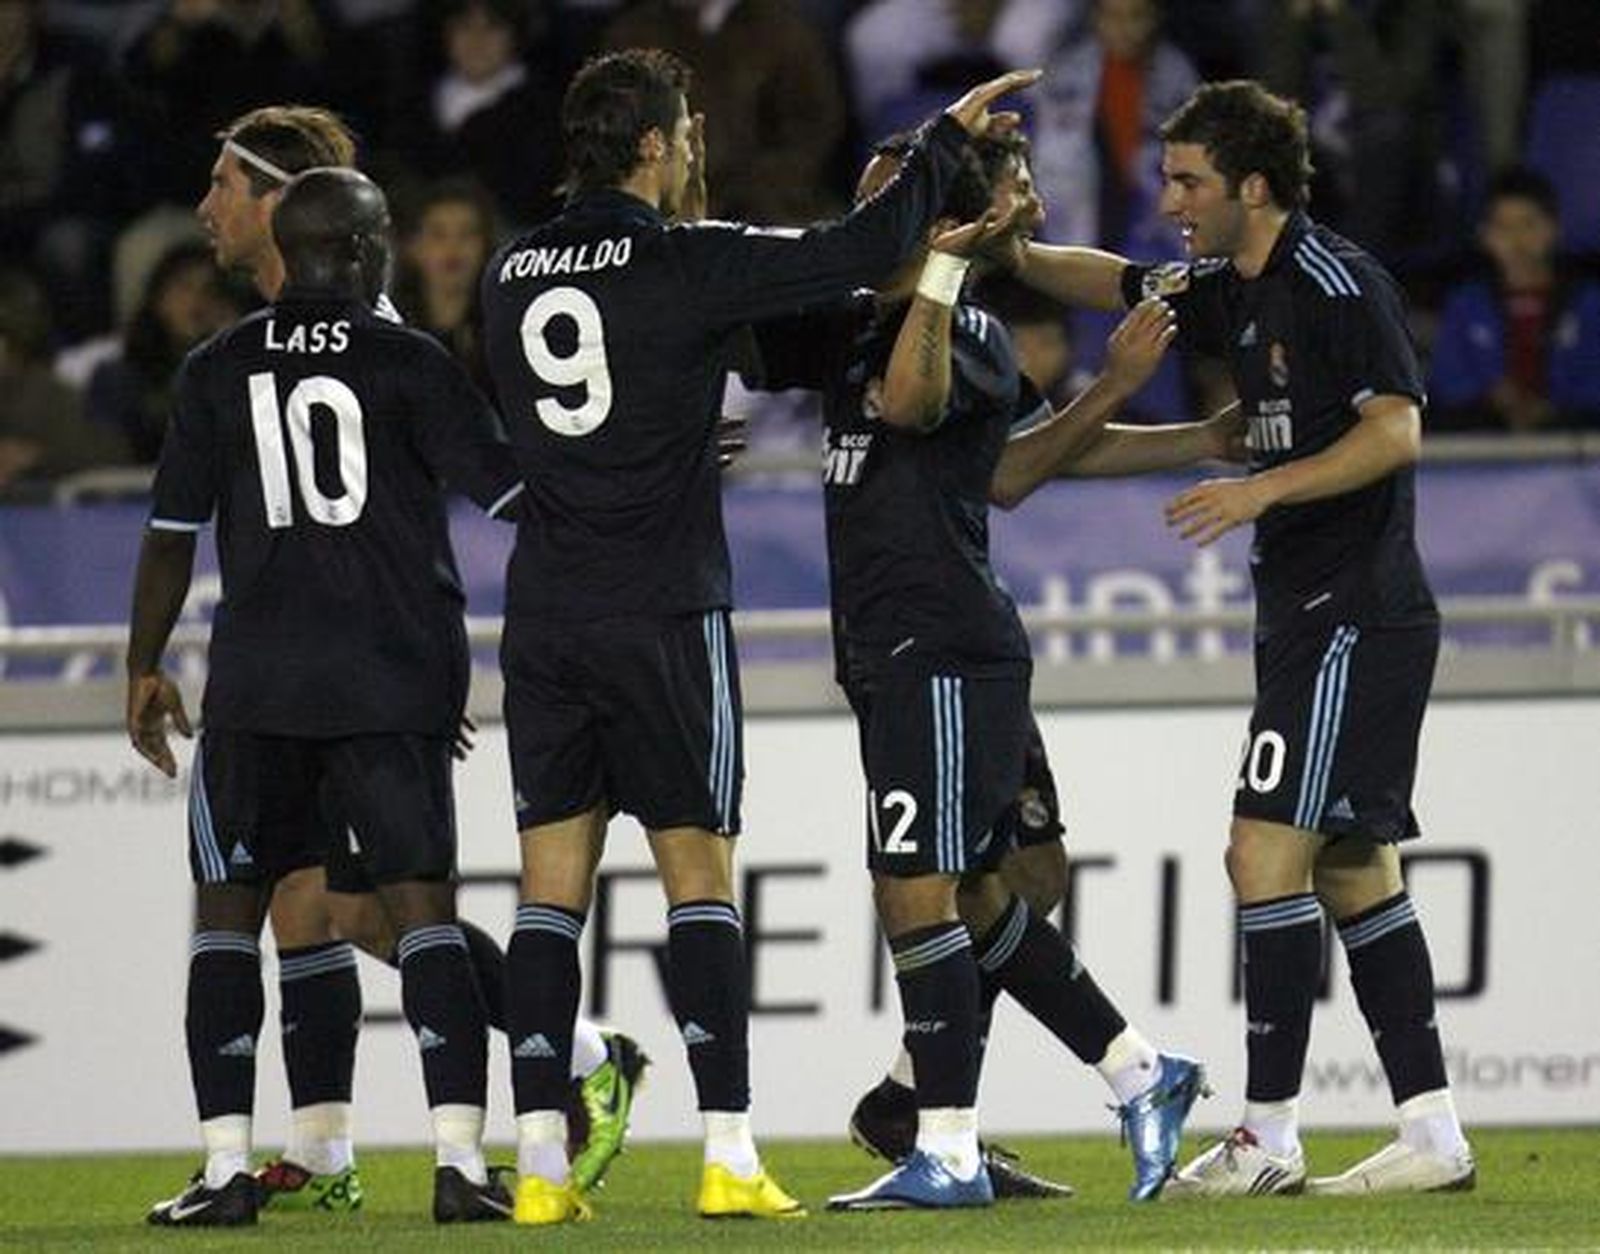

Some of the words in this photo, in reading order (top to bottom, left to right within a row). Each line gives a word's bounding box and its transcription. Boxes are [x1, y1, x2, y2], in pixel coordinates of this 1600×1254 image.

[499, 236, 632, 283] RONALDO
[264, 319, 351, 353] LASS
[520, 286, 613, 437] 9
[248, 371, 368, 528] 10
[1238, 729, 1287, 794] 0
